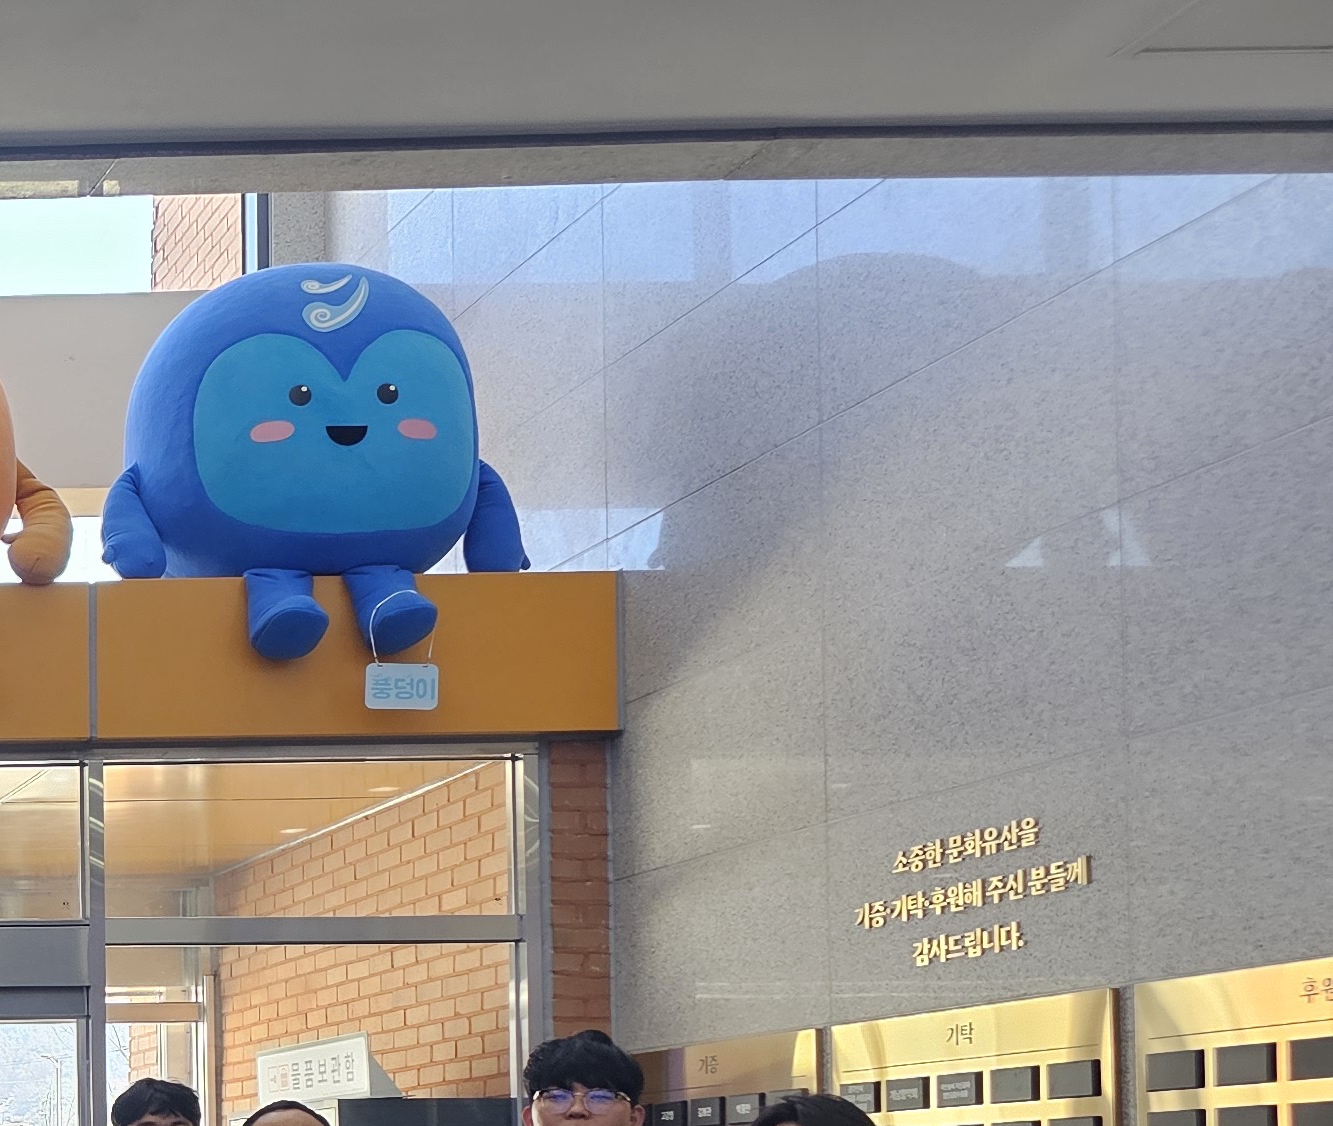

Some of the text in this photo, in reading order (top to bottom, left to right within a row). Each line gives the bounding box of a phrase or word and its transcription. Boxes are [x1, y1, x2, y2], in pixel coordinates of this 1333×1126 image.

[371, 677, 435, 701] 풍덩이
[892, 818, 1039, 873] 소중한 문화유산을
[986, 869, 1025, 904] 주신
[1028, 855, 1090, 896] 분들께
[912, 921, 1024, 966] 감사드립니다.
[946, 1022, 974, 1046] 기탁
[291, 1052, 354, 1090] 물품보관함
[698, 1055, 719, 1075] 기증
